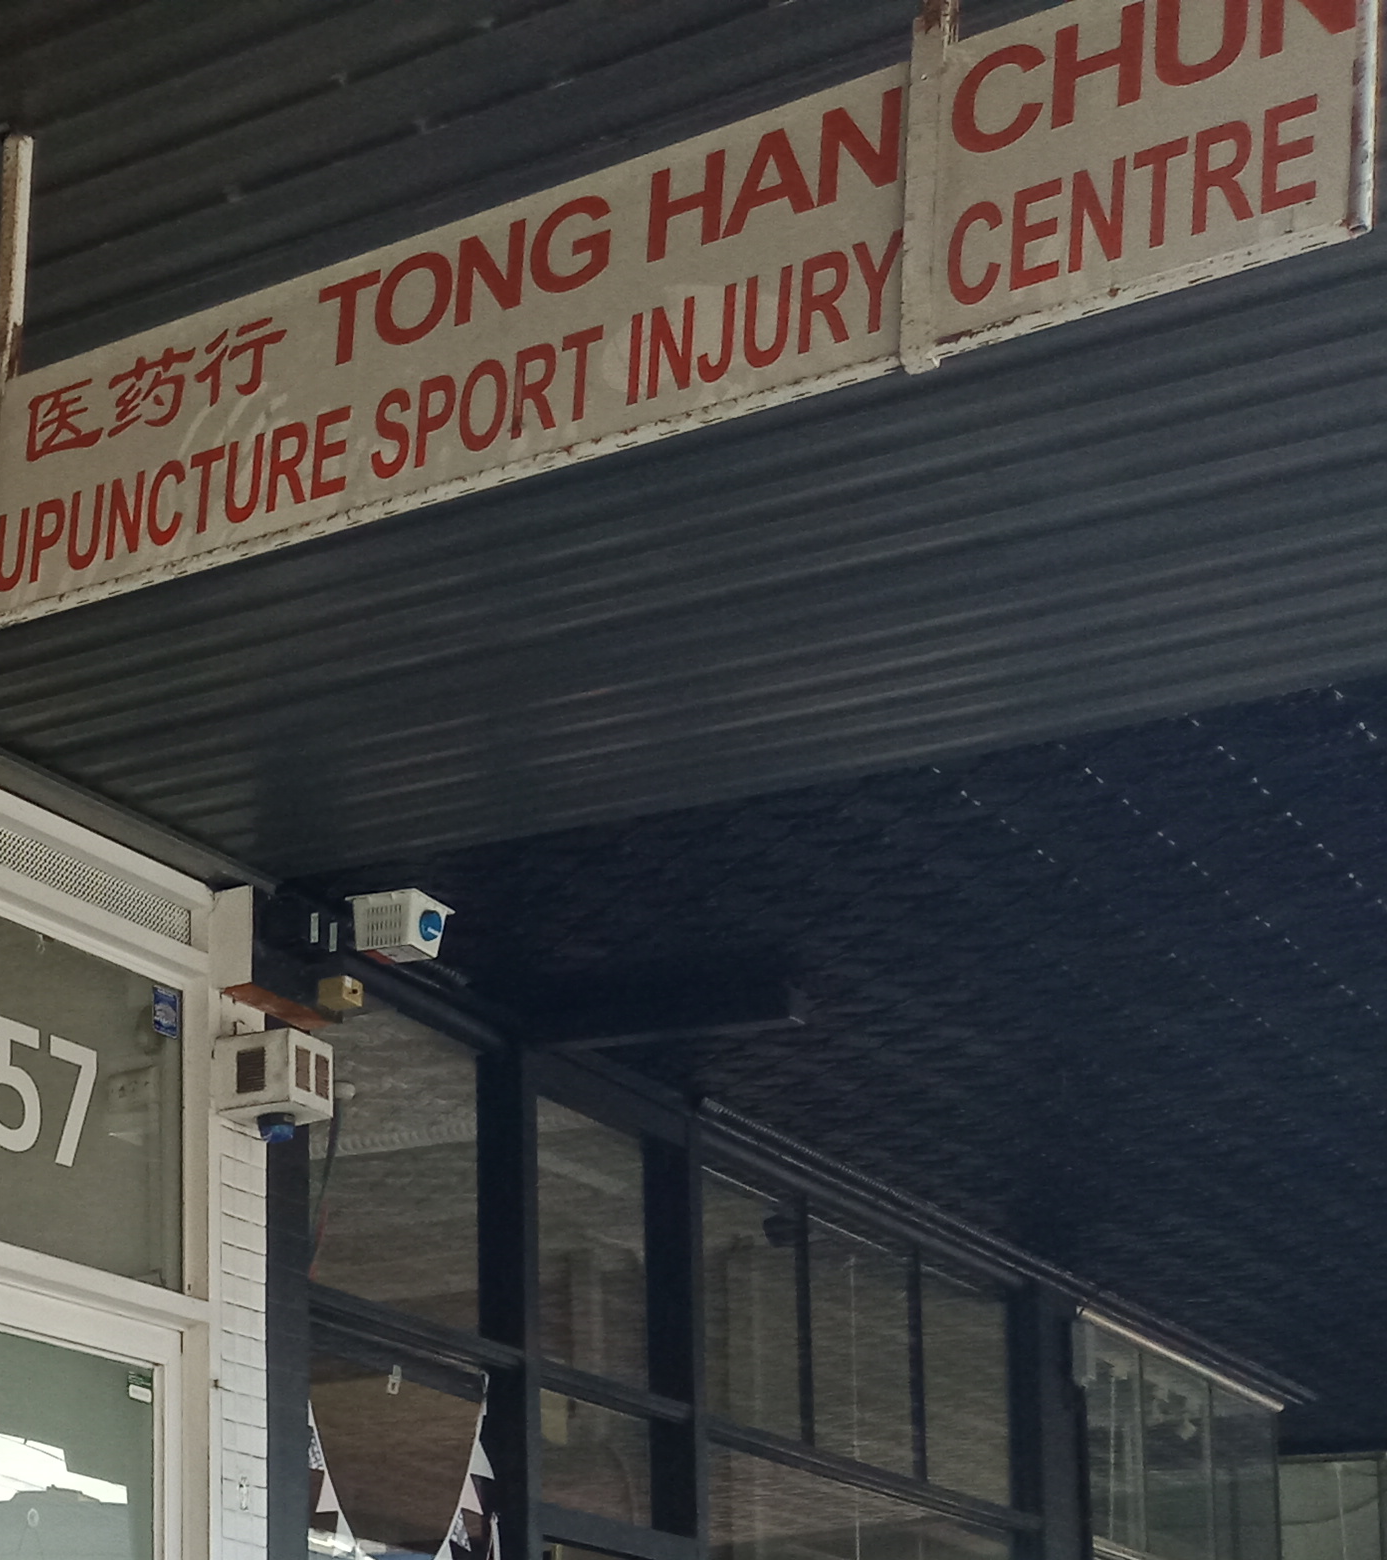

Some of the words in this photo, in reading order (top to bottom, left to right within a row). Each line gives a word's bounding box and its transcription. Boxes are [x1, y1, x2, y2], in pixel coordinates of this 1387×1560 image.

[320, 194, 612, 367] TONG
[646, 86, 903, 263] HAN
[371, 325, 604, 480] SPORT
[626, 228, 904, 406] INJURY
[947, 93, 1319, 306] CENTRE
[27, 316, 288, 462] 医药行
